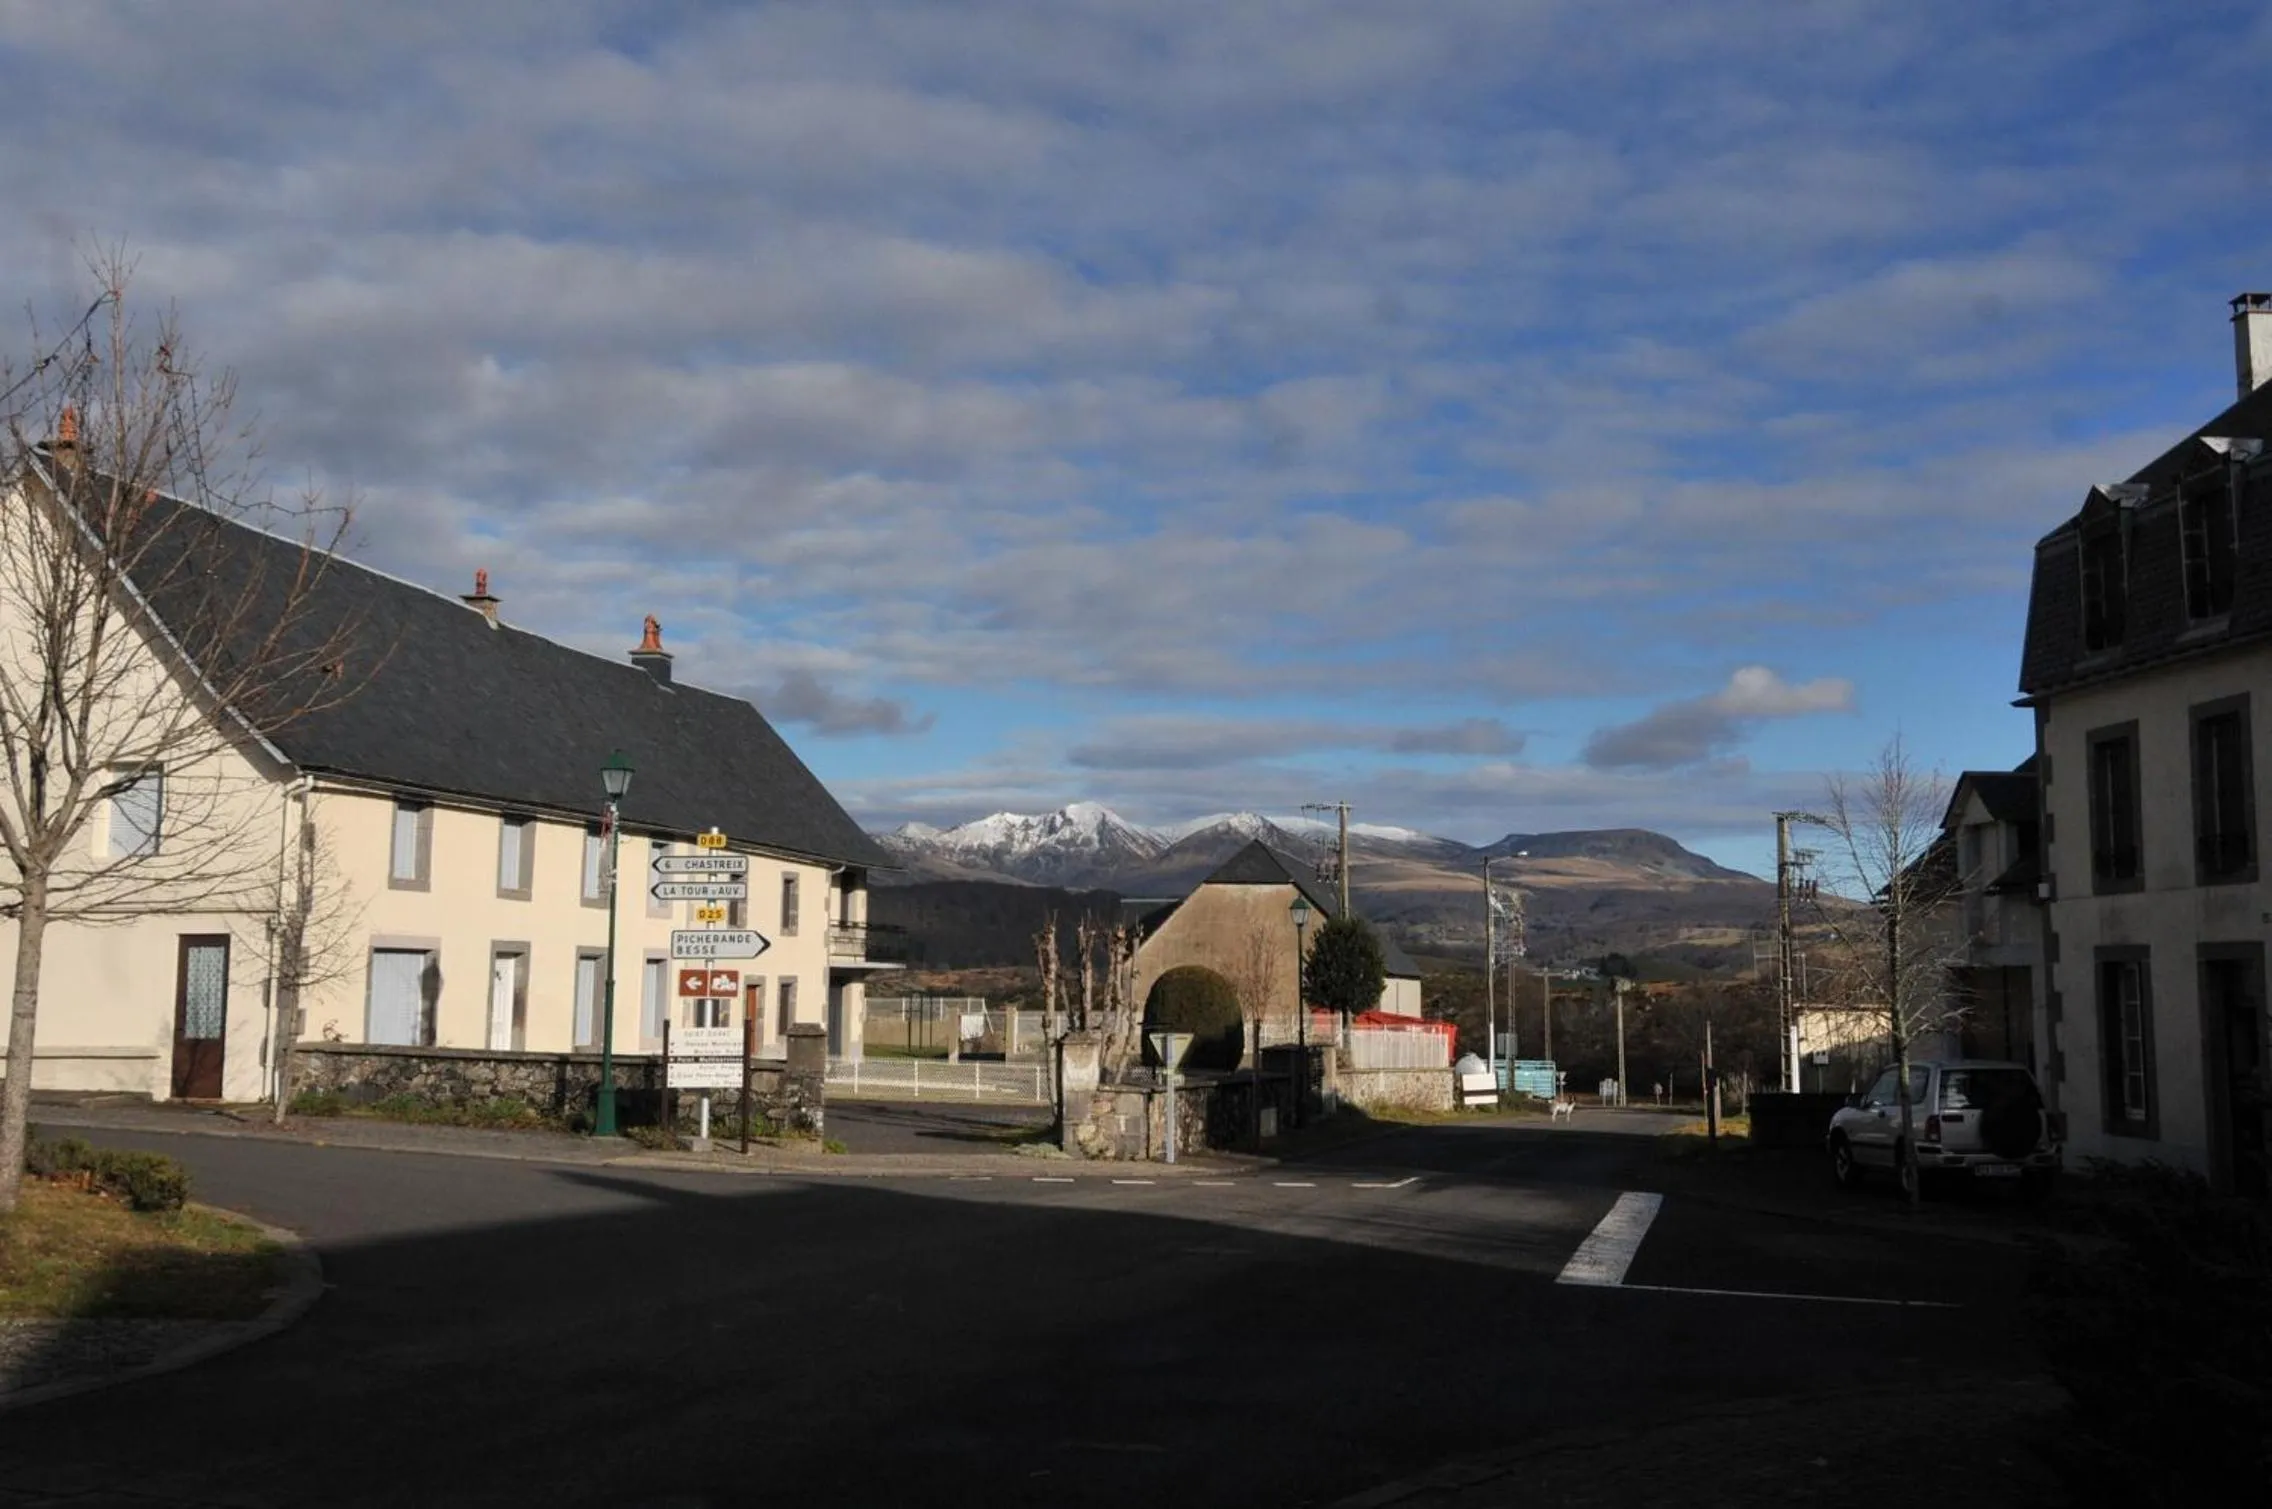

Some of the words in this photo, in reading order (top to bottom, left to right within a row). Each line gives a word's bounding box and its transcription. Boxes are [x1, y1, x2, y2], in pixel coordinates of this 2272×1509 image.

[684, 860, 743, 869] CHASTREIX
[663, 886, 676, 896] LA
[681, 886, 708, 896] TOUR
[677, 934, 752, 944] PICHERANDE
[677, 945, 716, 955] BESSE
